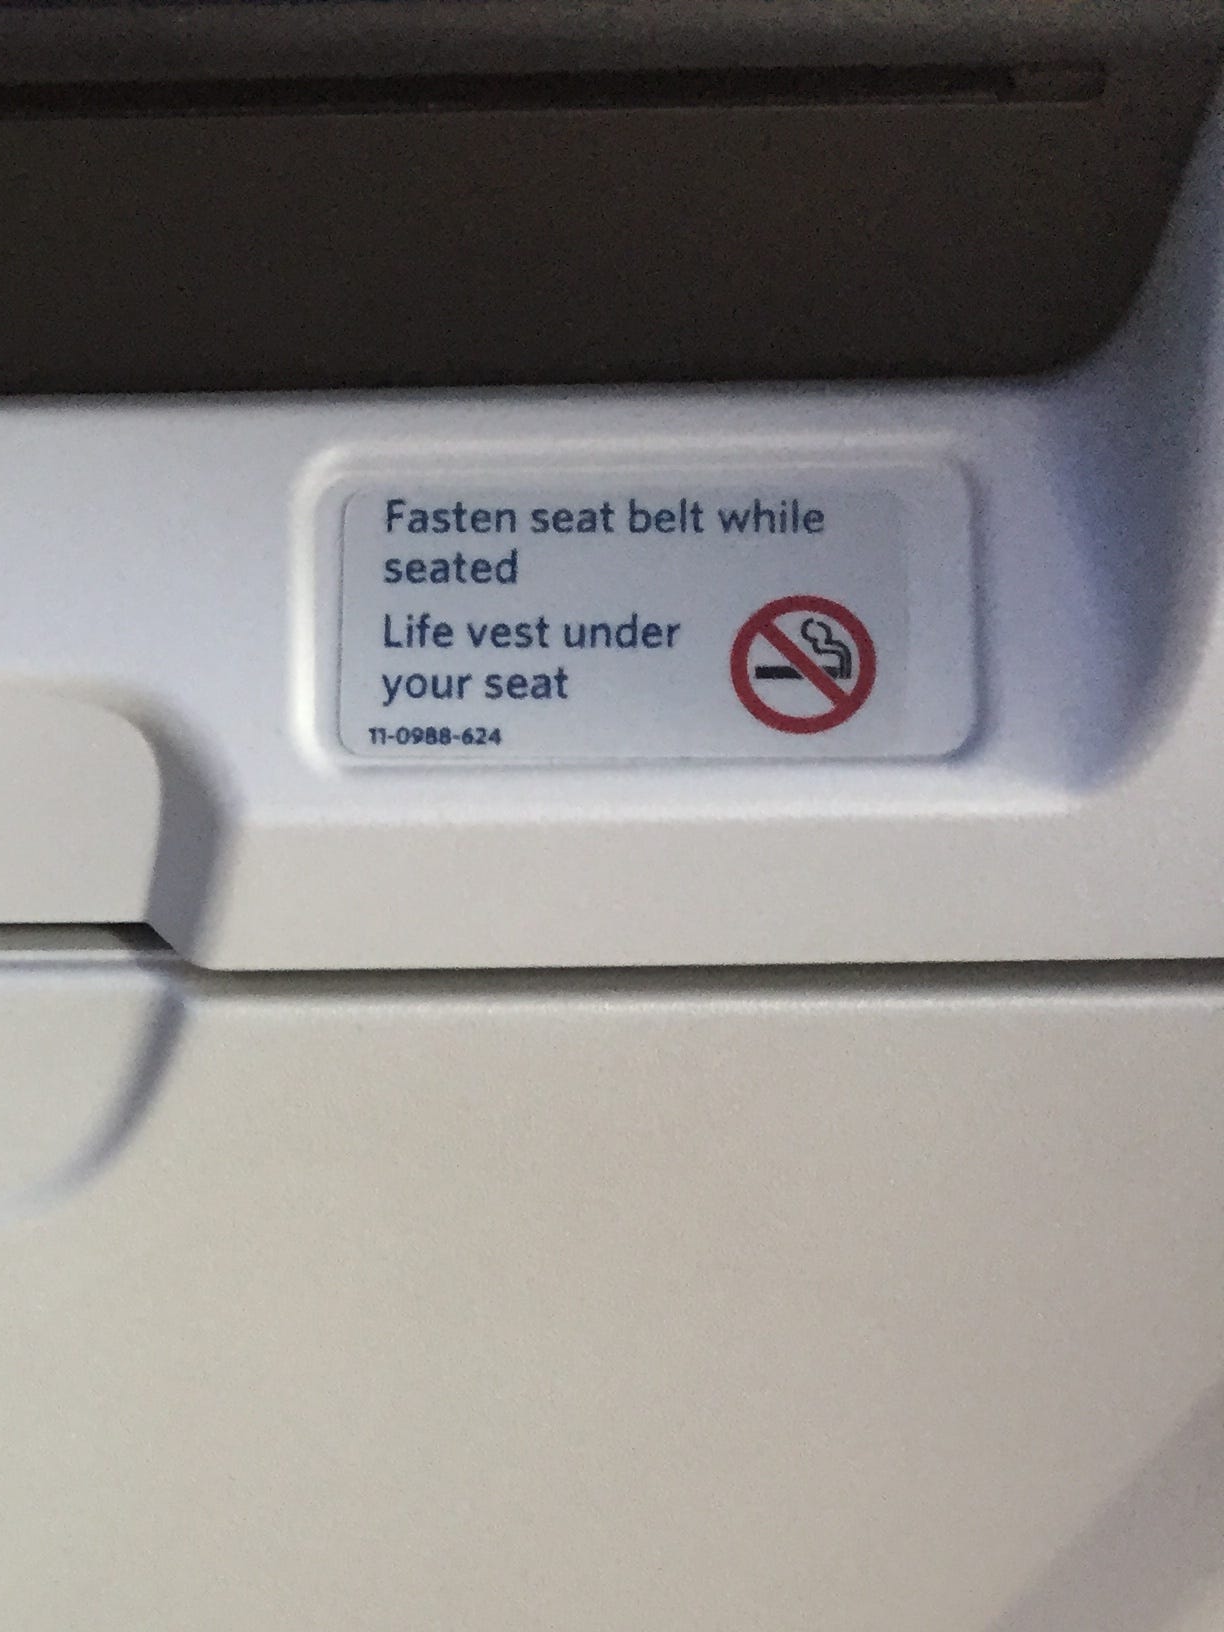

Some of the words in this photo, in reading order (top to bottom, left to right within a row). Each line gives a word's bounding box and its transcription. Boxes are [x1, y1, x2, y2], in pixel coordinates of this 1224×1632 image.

[385, 498, 517, 534] Fasten
[531, 501, 615, 534] seat
[628, 497, 705, 534] belt
[717, 498, 825, 534] while
[384, 547, 519, 585] seated
[383, 612, 454, 649] Life
[466, 616, 550, 649] vest
[563, 611, 681, 649] under
[382, 672, 473, 707] your
[484, 666, 569, 700] seat
[368, 726, 503, 746] 11-0988-624
